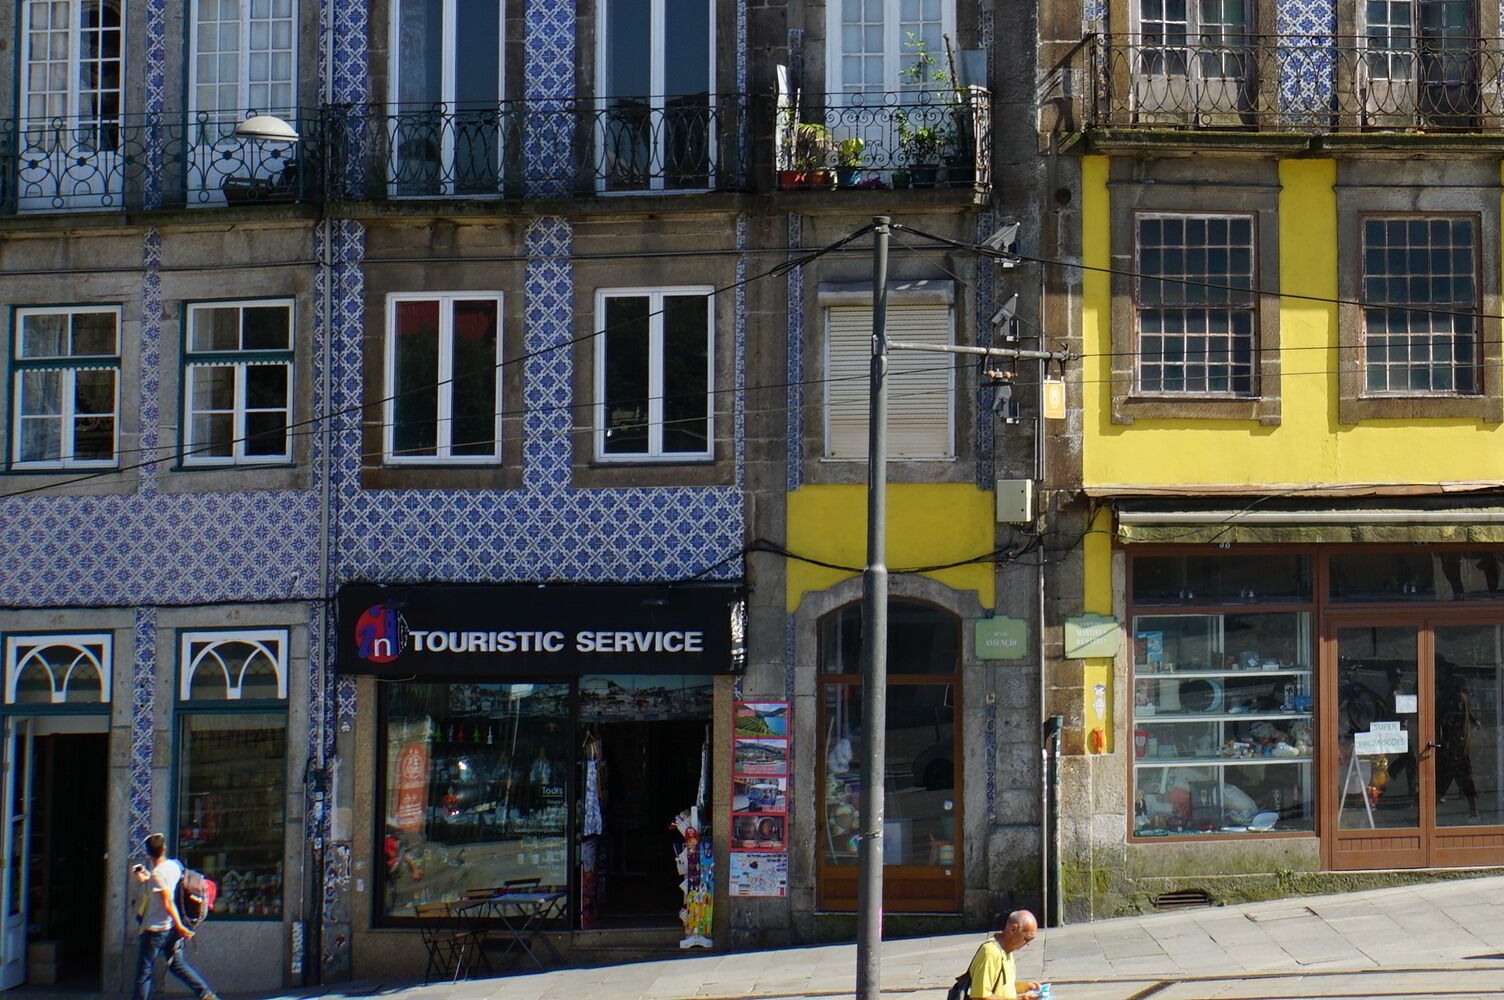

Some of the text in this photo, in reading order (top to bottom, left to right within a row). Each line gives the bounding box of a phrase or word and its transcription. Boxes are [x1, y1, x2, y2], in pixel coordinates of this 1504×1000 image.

[409, 631, 704, 652] TOURISTIC SERVICE
[542, 786, 563, 795] Tours
